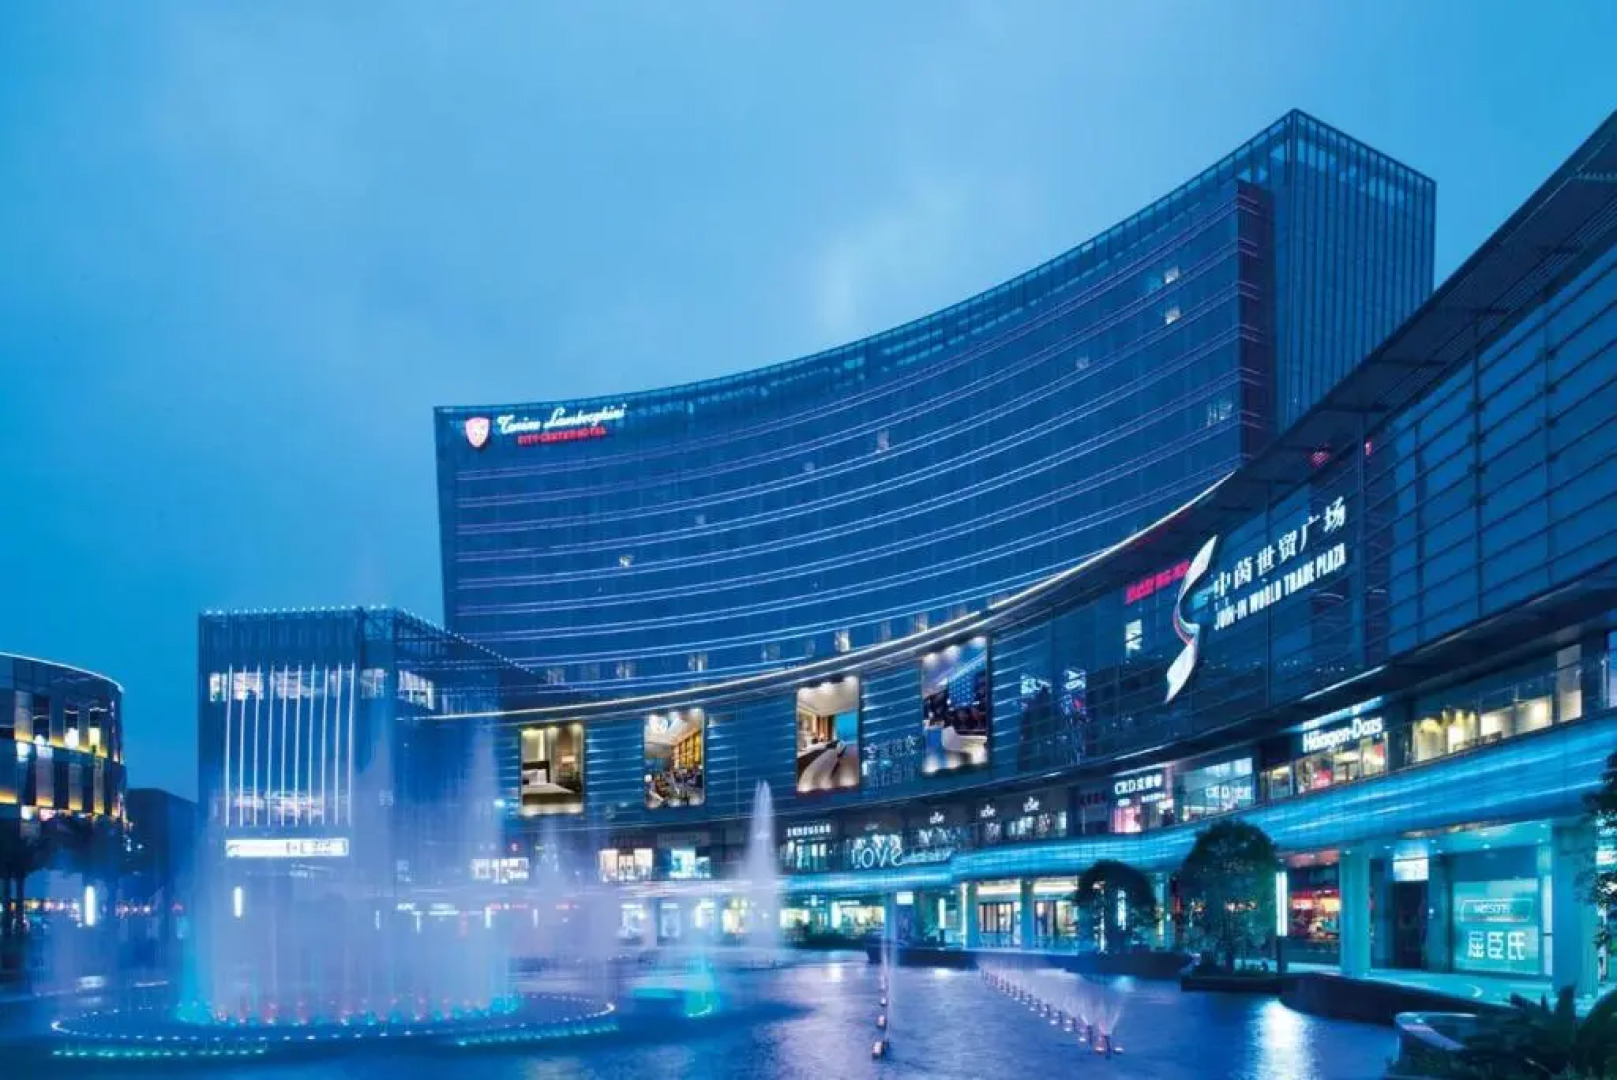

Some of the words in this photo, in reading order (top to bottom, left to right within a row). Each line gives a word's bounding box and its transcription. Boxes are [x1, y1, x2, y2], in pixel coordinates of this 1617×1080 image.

[1249, 580, 1281, 614] WORLD
[1284, 561, 1314, 596] TRADE
[1317, 542, 1346, 578] PLAZA
[1468, 930, 1526, 961] 屈臣氏
